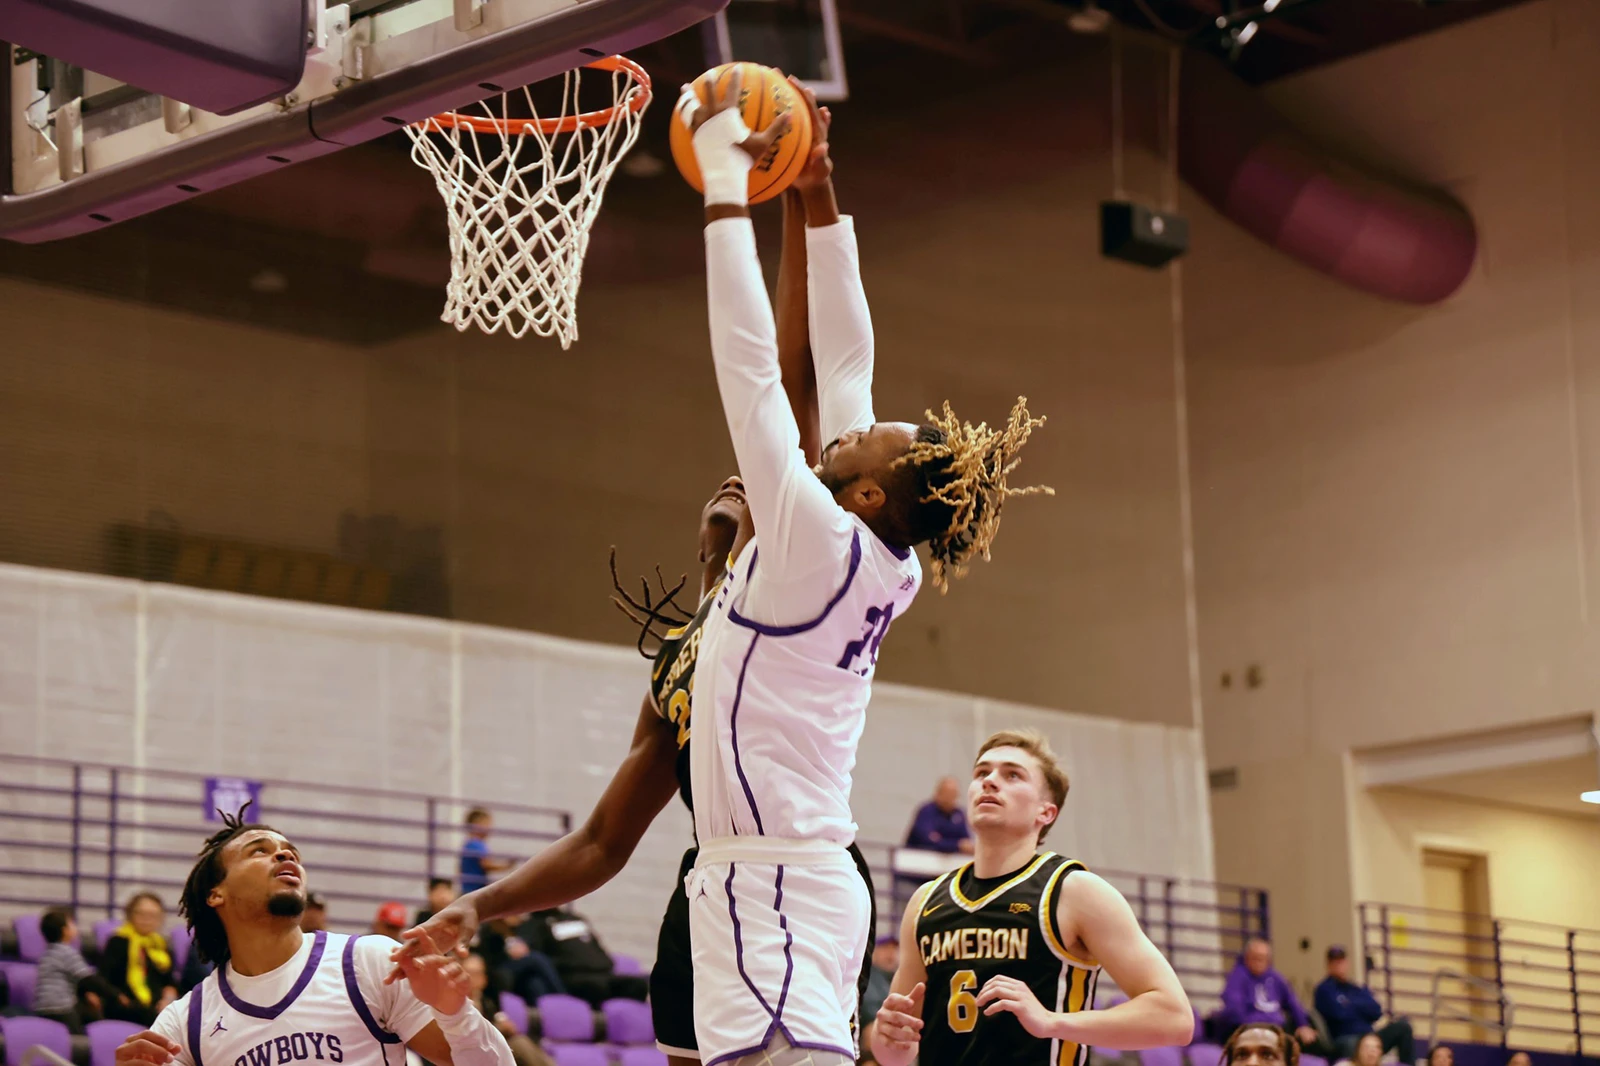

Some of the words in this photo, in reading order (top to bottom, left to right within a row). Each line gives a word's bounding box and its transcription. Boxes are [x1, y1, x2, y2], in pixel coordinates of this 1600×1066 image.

[668, 671, 696, 750] 2
[920, 927, 1029, 967] CAMERON
[947, 969, 979, 1034] 6
